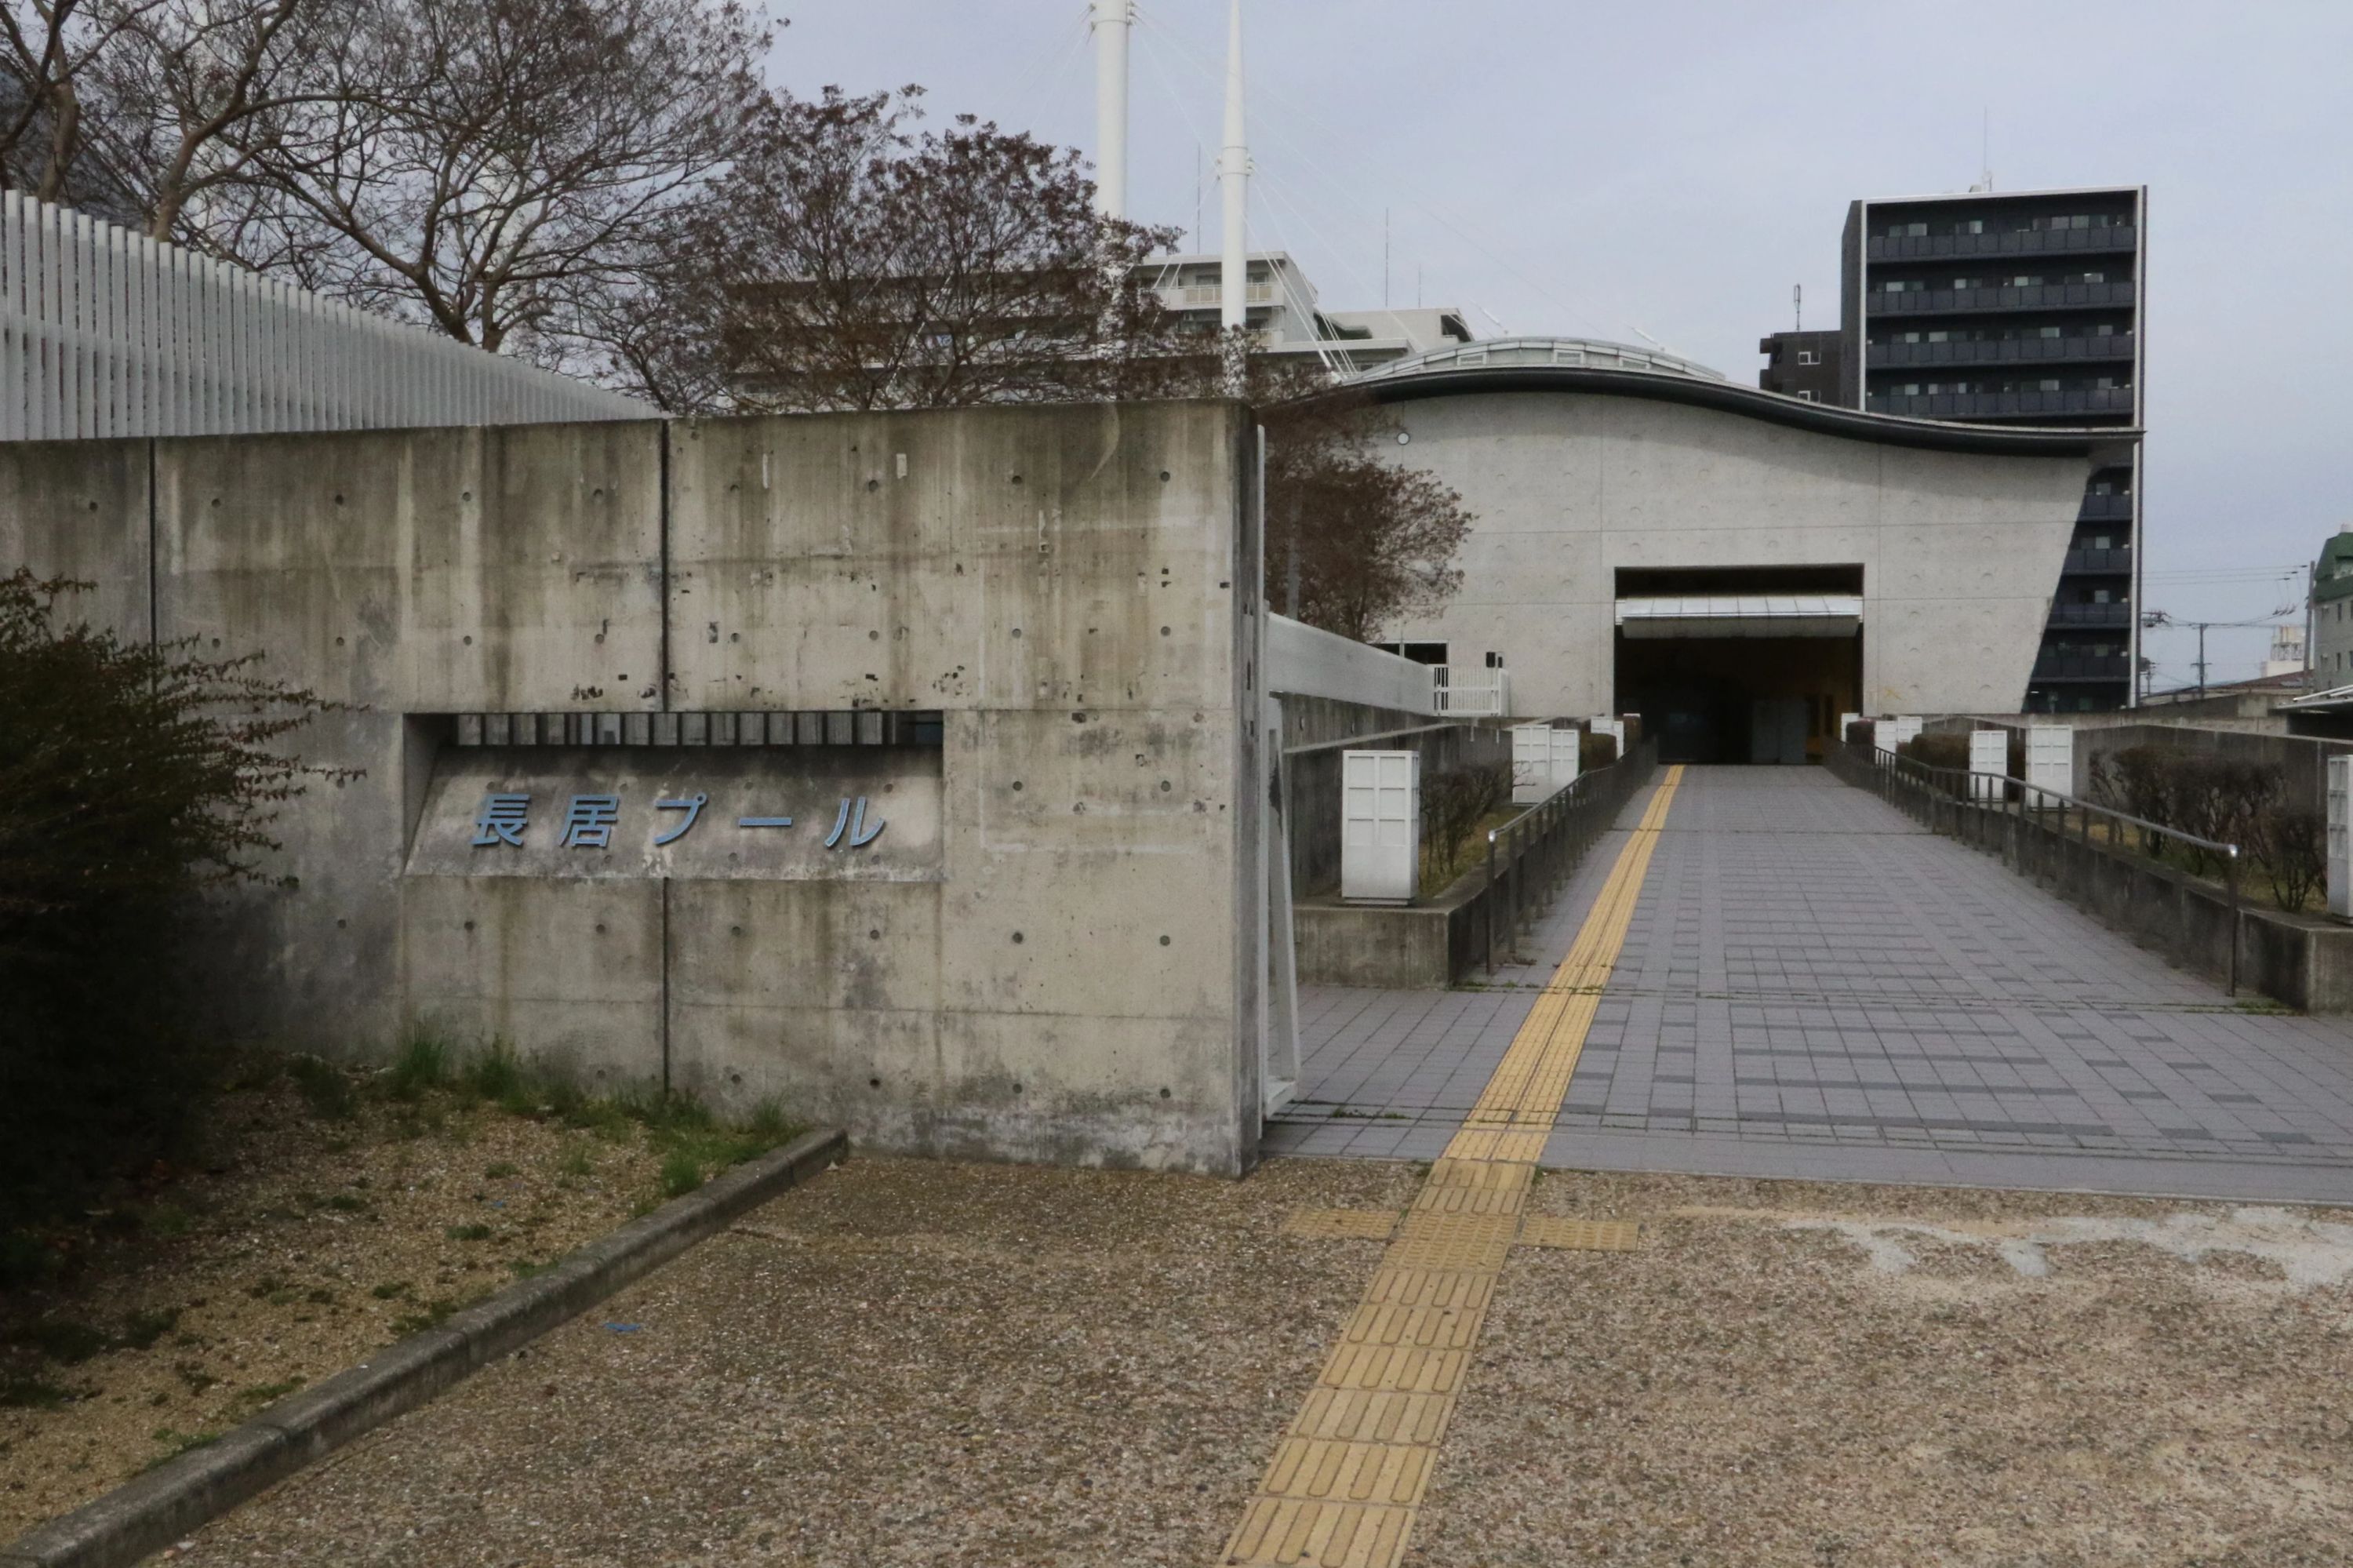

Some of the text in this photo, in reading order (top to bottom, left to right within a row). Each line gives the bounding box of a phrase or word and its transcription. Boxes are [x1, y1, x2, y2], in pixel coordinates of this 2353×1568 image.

[471, 793, 886, 848] 長居プール
